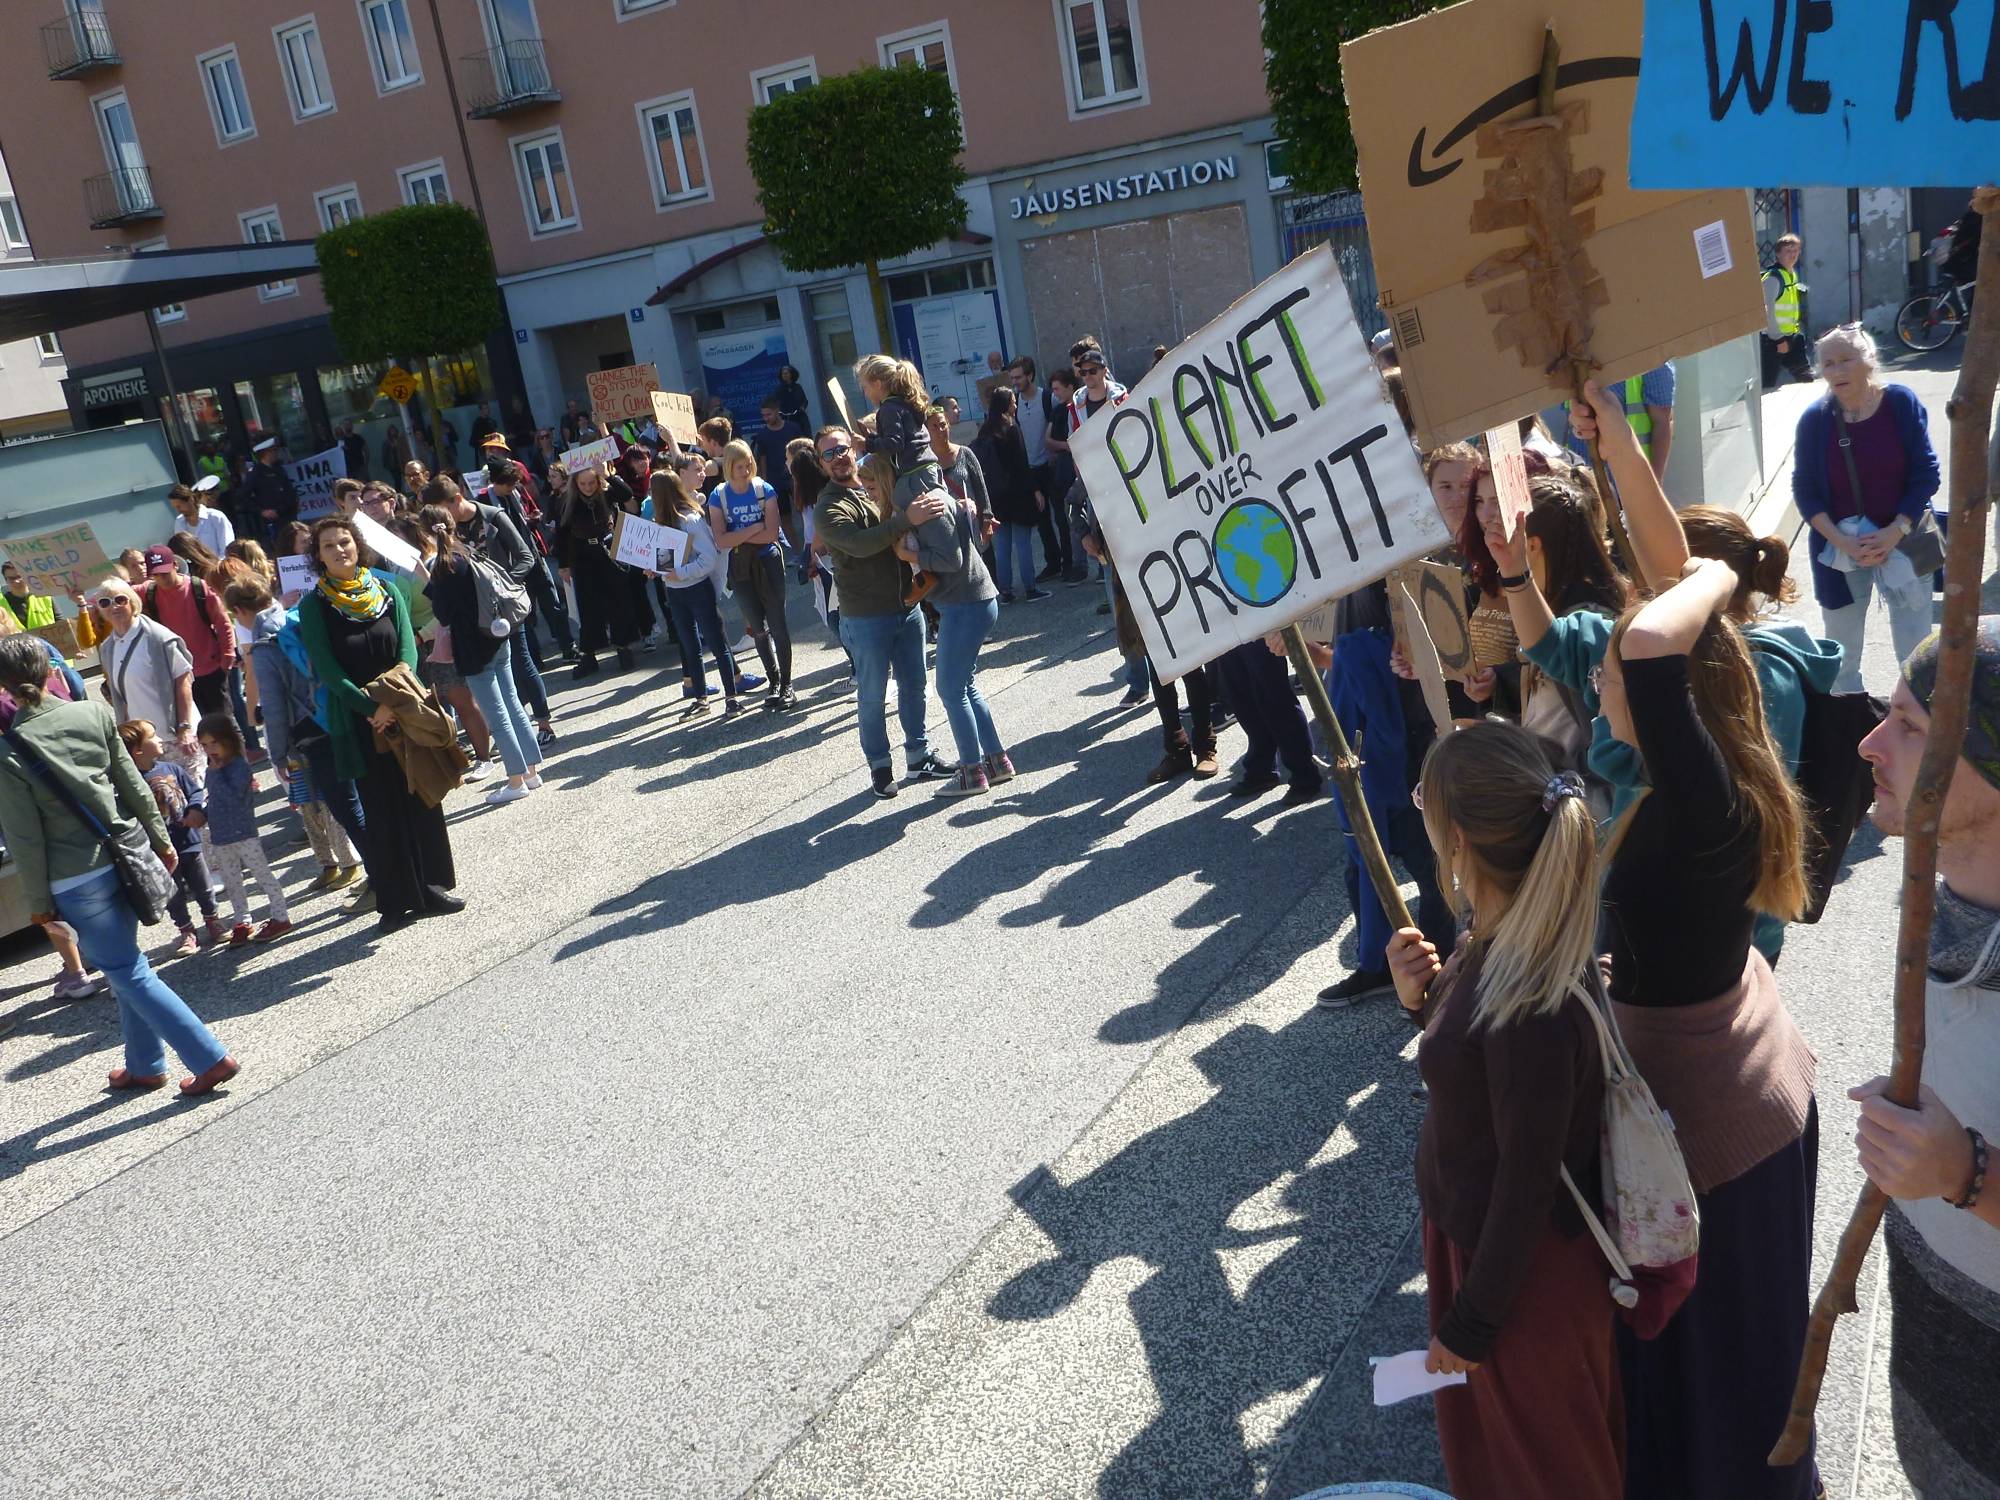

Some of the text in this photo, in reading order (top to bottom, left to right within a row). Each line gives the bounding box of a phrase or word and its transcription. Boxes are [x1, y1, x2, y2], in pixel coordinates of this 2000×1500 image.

[1699, 0, 2000, 123] WE R
[1010, 155, 1238, 220] JAUSENSTATION
[588, 364, 649, 386] CHANGE THE
[609, 377, 644, 392] SYSTEM
[84, 379, 149, 406] APOTHEKE
[595, 394, 652, 417] NOT CLIMA
[1105, 287, 1326, 524] PLANET
[288, 460, 334, 483] IMA
[1195, 453, 1263, 516] OVER
[3, 527, 94, 557] MAKE THE
[1138, 424, 1394, 660] PROFIT
[15, 549, 80, 573] WORLD
